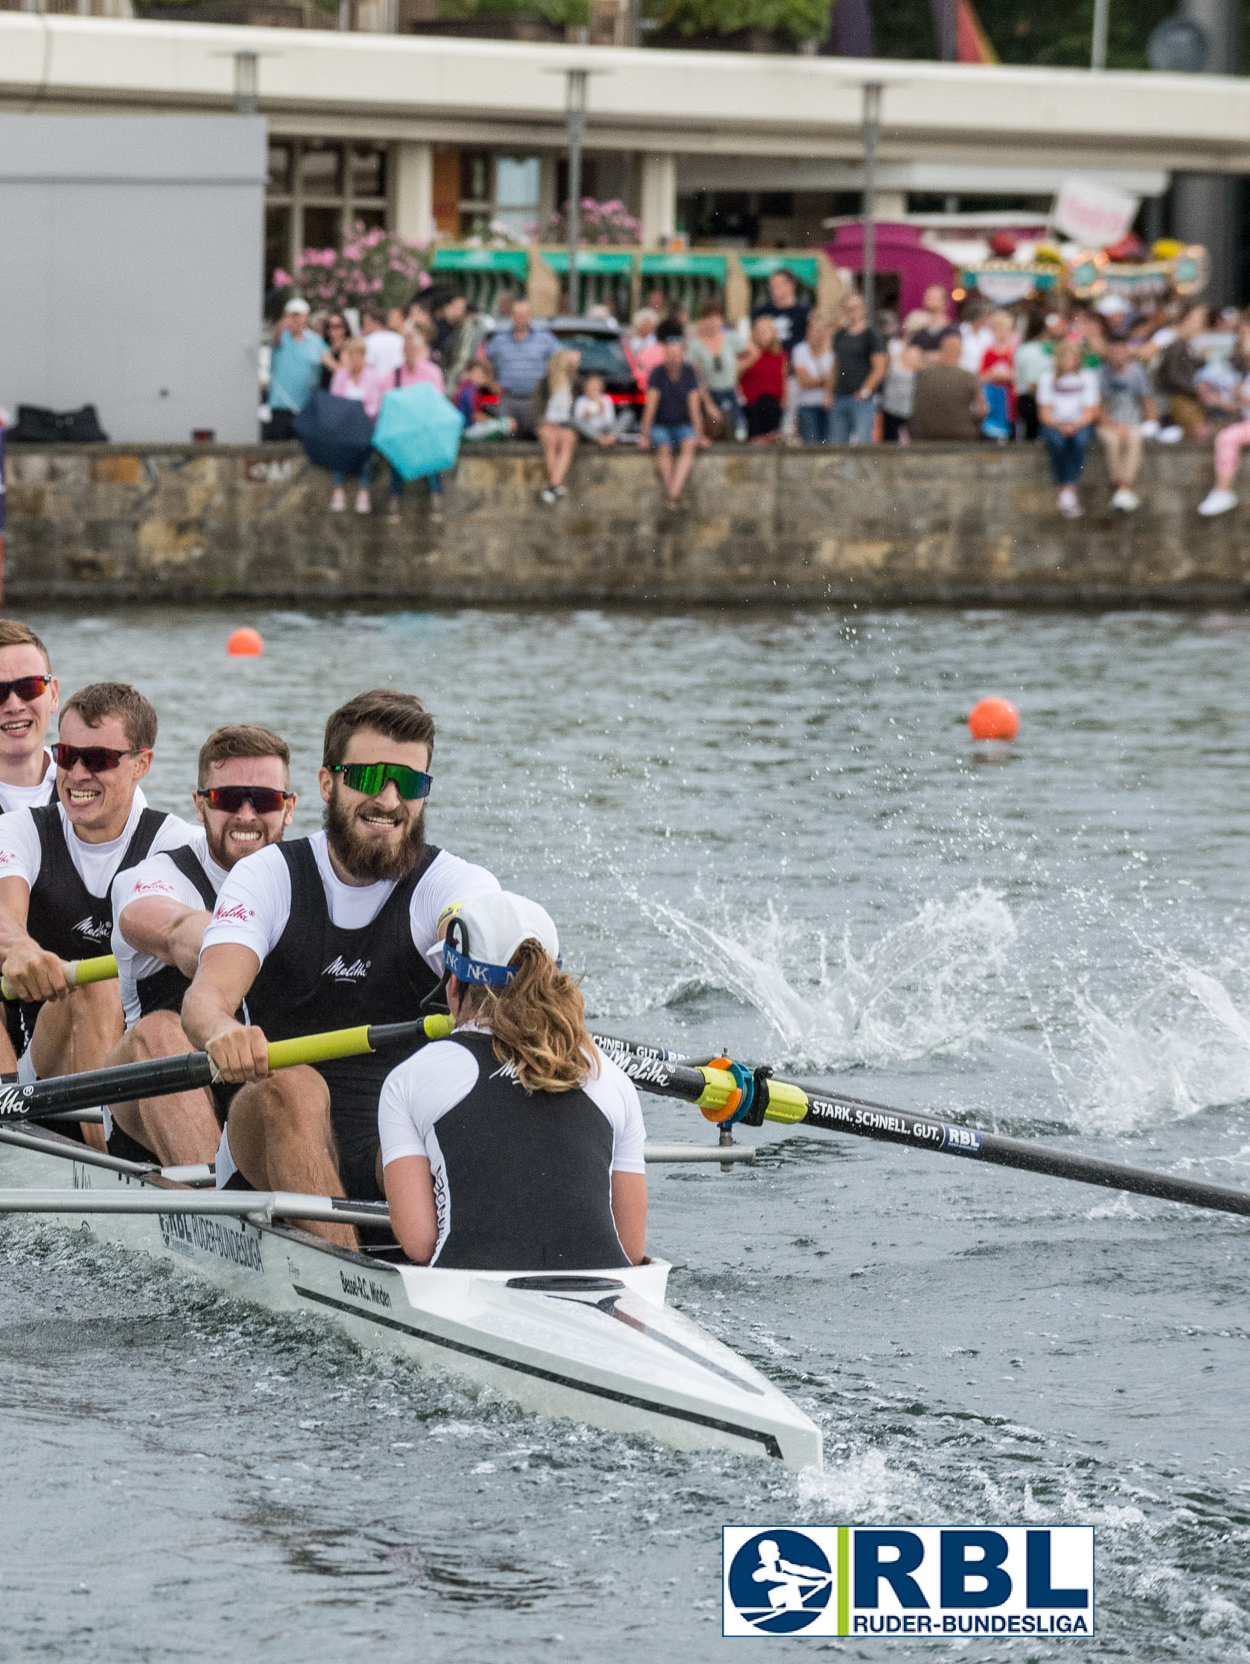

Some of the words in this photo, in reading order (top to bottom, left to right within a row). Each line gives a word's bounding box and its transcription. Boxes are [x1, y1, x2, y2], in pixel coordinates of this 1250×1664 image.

[445, 950, 458, 970] NK
[466, 963, 489, 982] NK
[636, 1046, 660, 1061] GUT.
[812, 1100, 853, 1122] STARK.
[855, 1110, 911, 1135] SCHNELL.
[913, 1123, 940, 1141] GUT.
[948, 1127, 981, 1148] RBL
[369, 1280, 393, 1310] Minden
